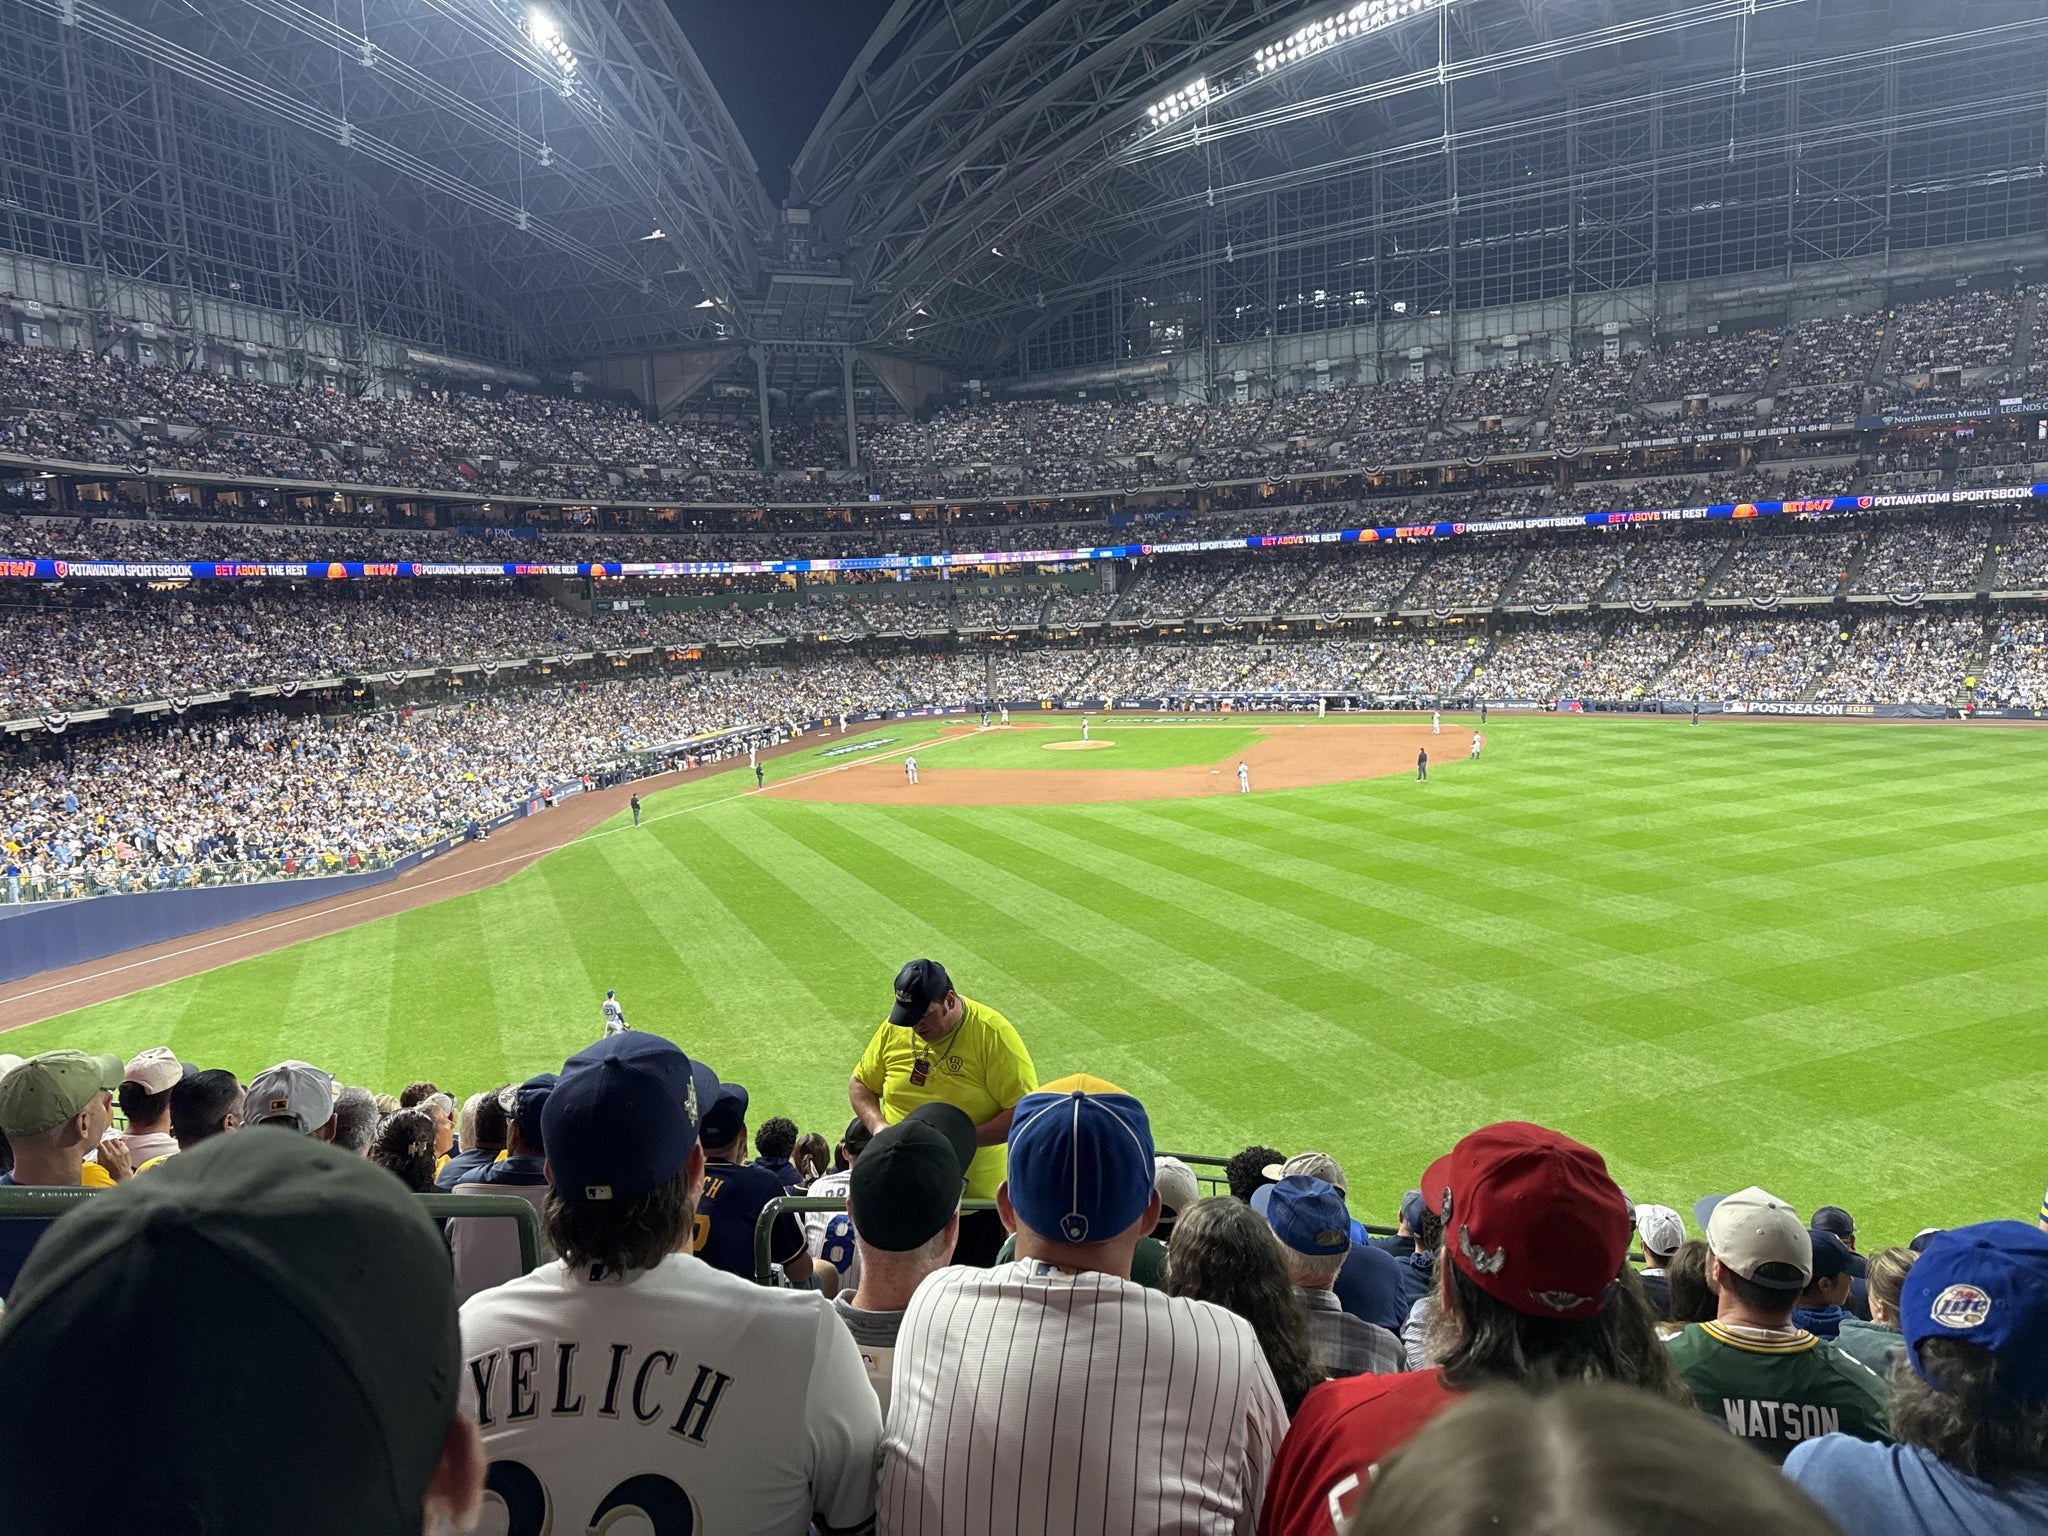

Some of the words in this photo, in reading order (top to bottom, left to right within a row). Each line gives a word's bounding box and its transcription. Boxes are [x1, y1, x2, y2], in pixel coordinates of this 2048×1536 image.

[2000, 402, 2041, 414] LEGENDS
[1894, 412, 1955, 424] Northwestern
[1958, 408, 1991, 418] Mutual
[1874, 492, 1950, 507] POTAWATOMI
[1952, 487, 2033, 502] SPORTSBOOK
[1144, 512, 1165, 521] PNC
[1608, 514, 1627, 523] BET
[1627, 512, 1660, 522] ABOVE
[1661, 510, 1681, 520] THE
[1682, 508, 1708, 519] REST
[1466, 520, 1524, 533] POTAWATOMI
[1525, 516, 1586, 529] SPORTSBOOK
[494, 528, 514, 539] PNC
[1261, 537, 1277, 546] BET
[1277, 536, 1304, 545] ABOVE
[1304, 534, 1320, 544] THE
[1321, 533, 1341, 543] REST
[1152, 543, 1198, 554] POTAWATOMI
[1199, 540, 1247, 551] SPORTSBOOK
[68, 563, 125, 577] POTAWATOMI
[125, 564, 193, 577] SPORTSBOOK
[215, 565, 234, 576] BET
[235, 565, 266, 576] ABOVE
[266, 565, 285, 576] THE
[285, 565, 308, 576] REST
[422, 565, 464, 575] POTAWATOMI
[465, 565, 505, 575] SPORTSBOOK
[515, 565, 527, 575] BET
[527, 565, 548, 575] ABOVE
[548, 565, 561, 575] THE
[561, 565, 578, 575] REST
[1748, 702, 1843, 715] POSTSEASON
[467, 1341, 734, 1448] YELICH
[1723, 1398, 1839, 1441] WATSON
